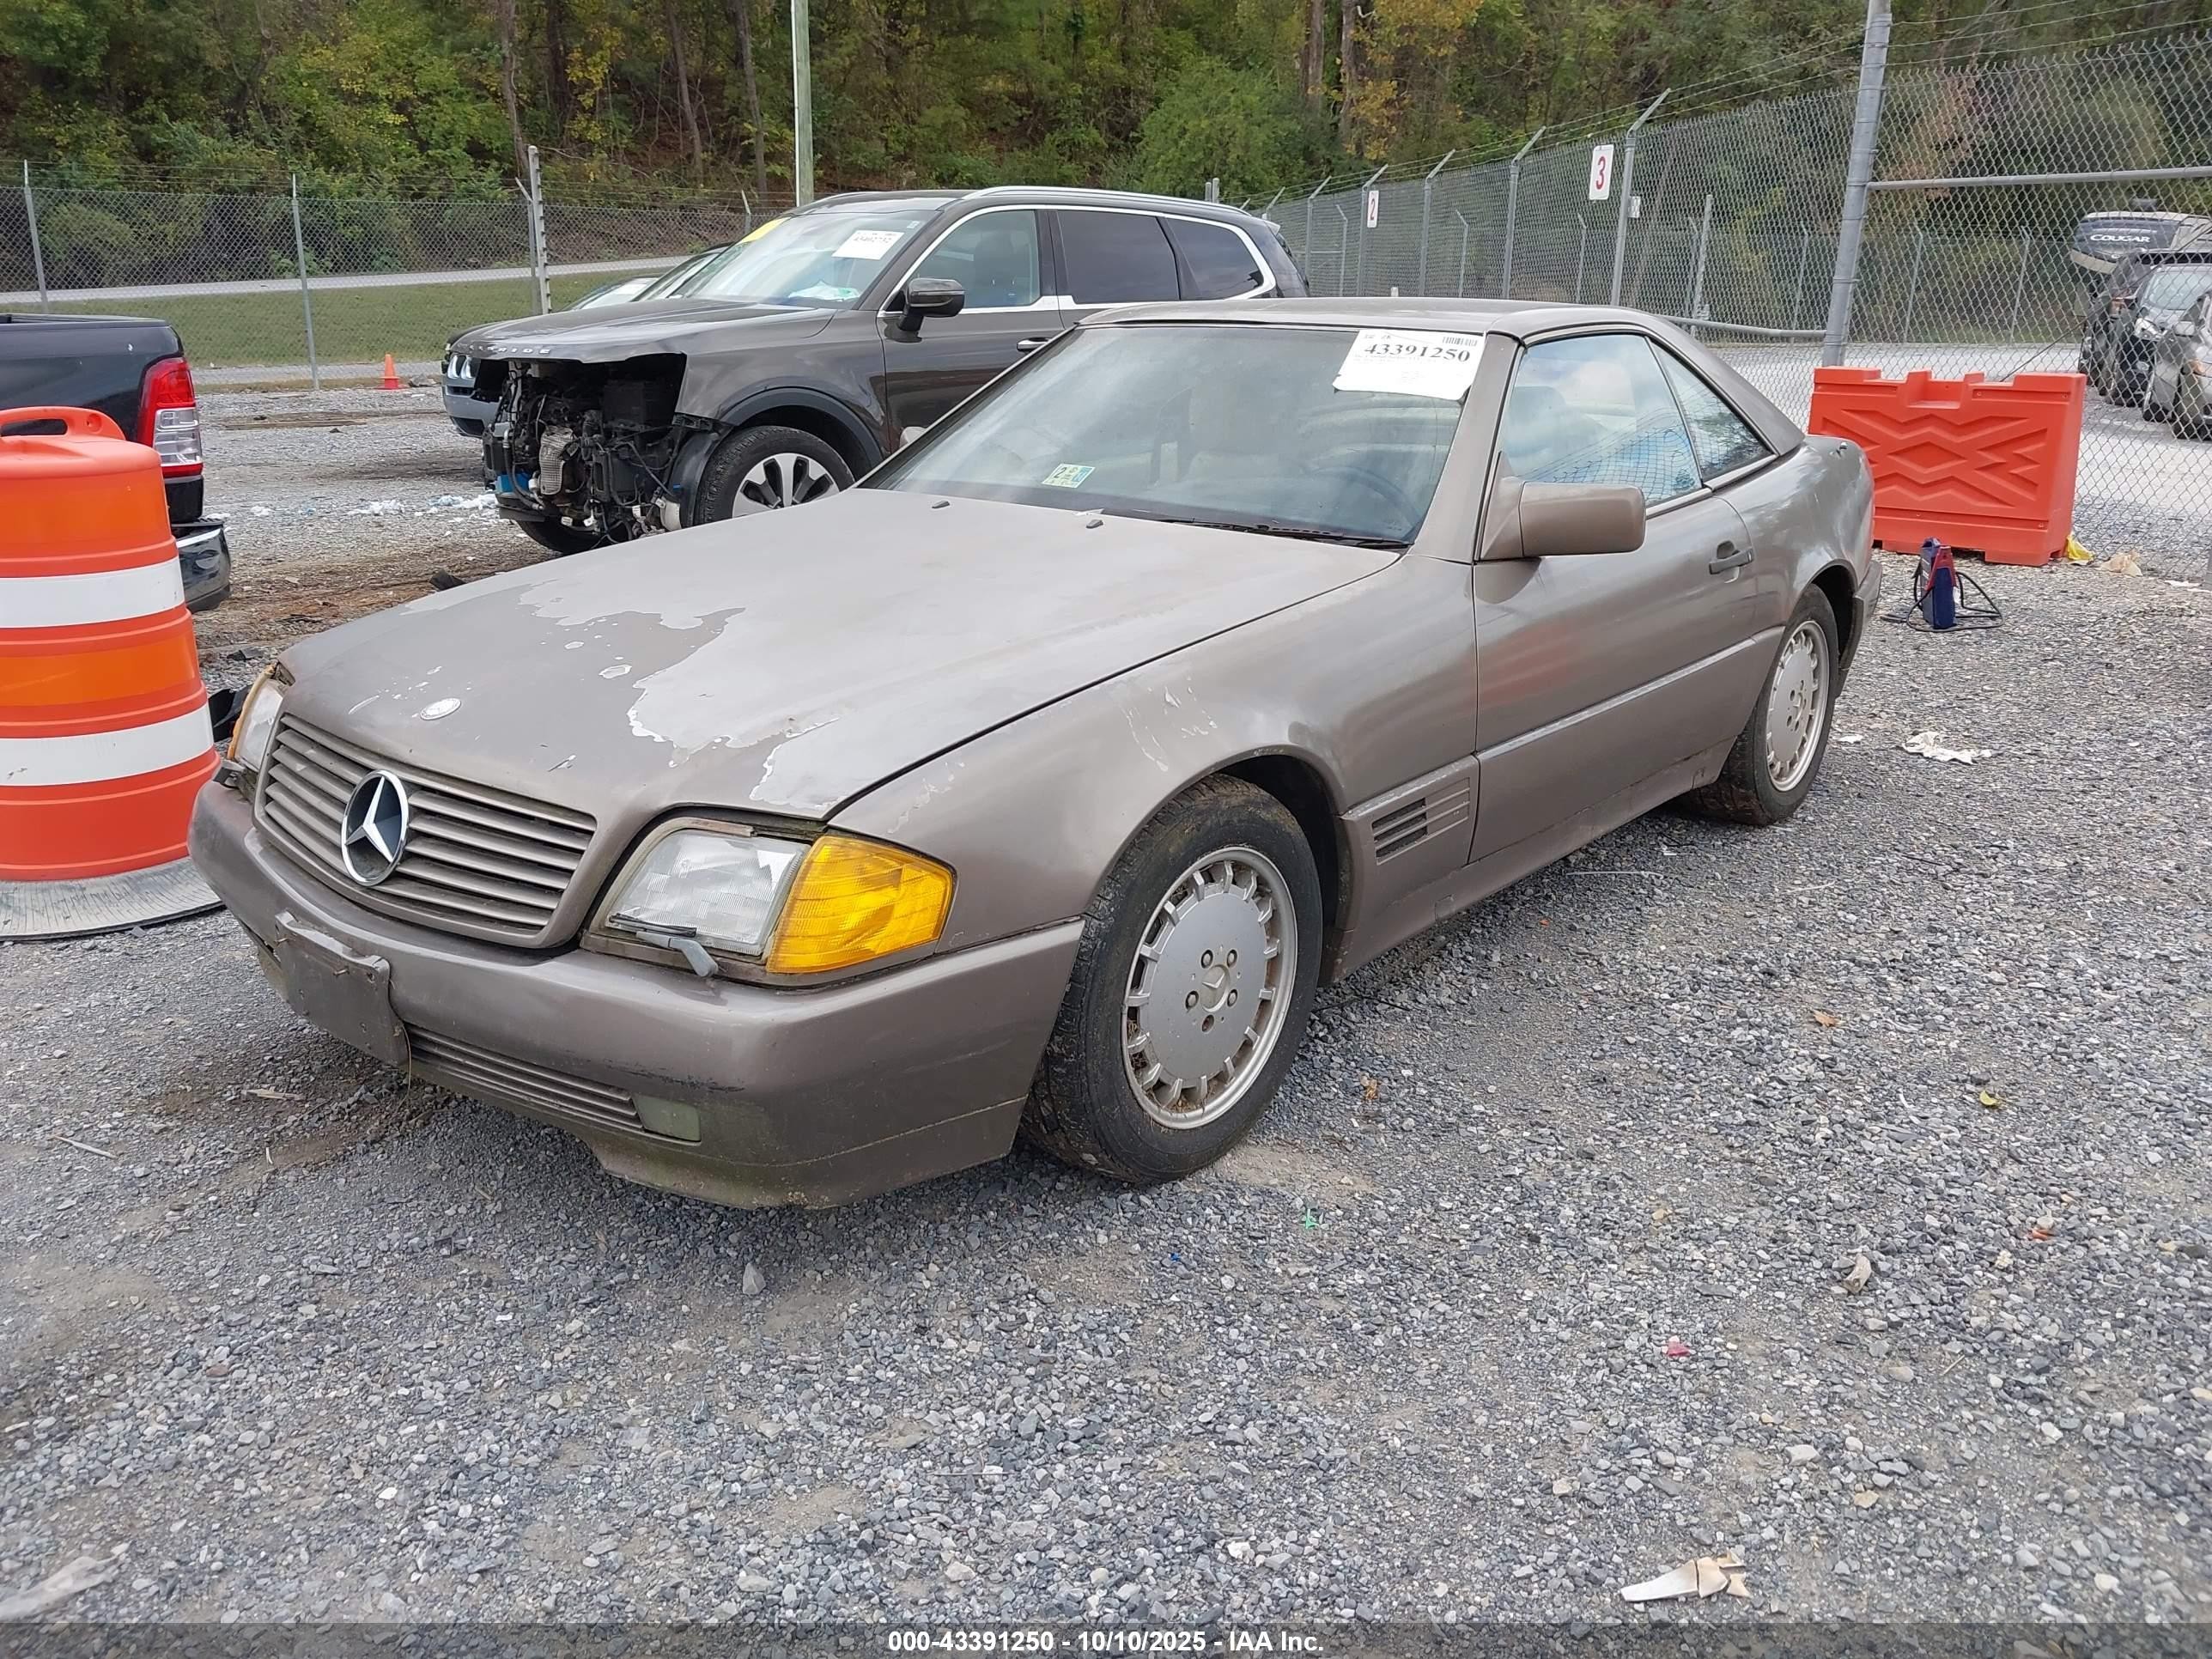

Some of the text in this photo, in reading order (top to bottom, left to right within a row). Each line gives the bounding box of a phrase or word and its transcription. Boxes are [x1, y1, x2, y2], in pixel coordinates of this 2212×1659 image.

[1595, 155, 1607, 191] 3
[1370, 198, 1376, 221] 2
[2090, 234, 2151, 243] COUGAR
[1364, 343, 1471, 362] 43391250
